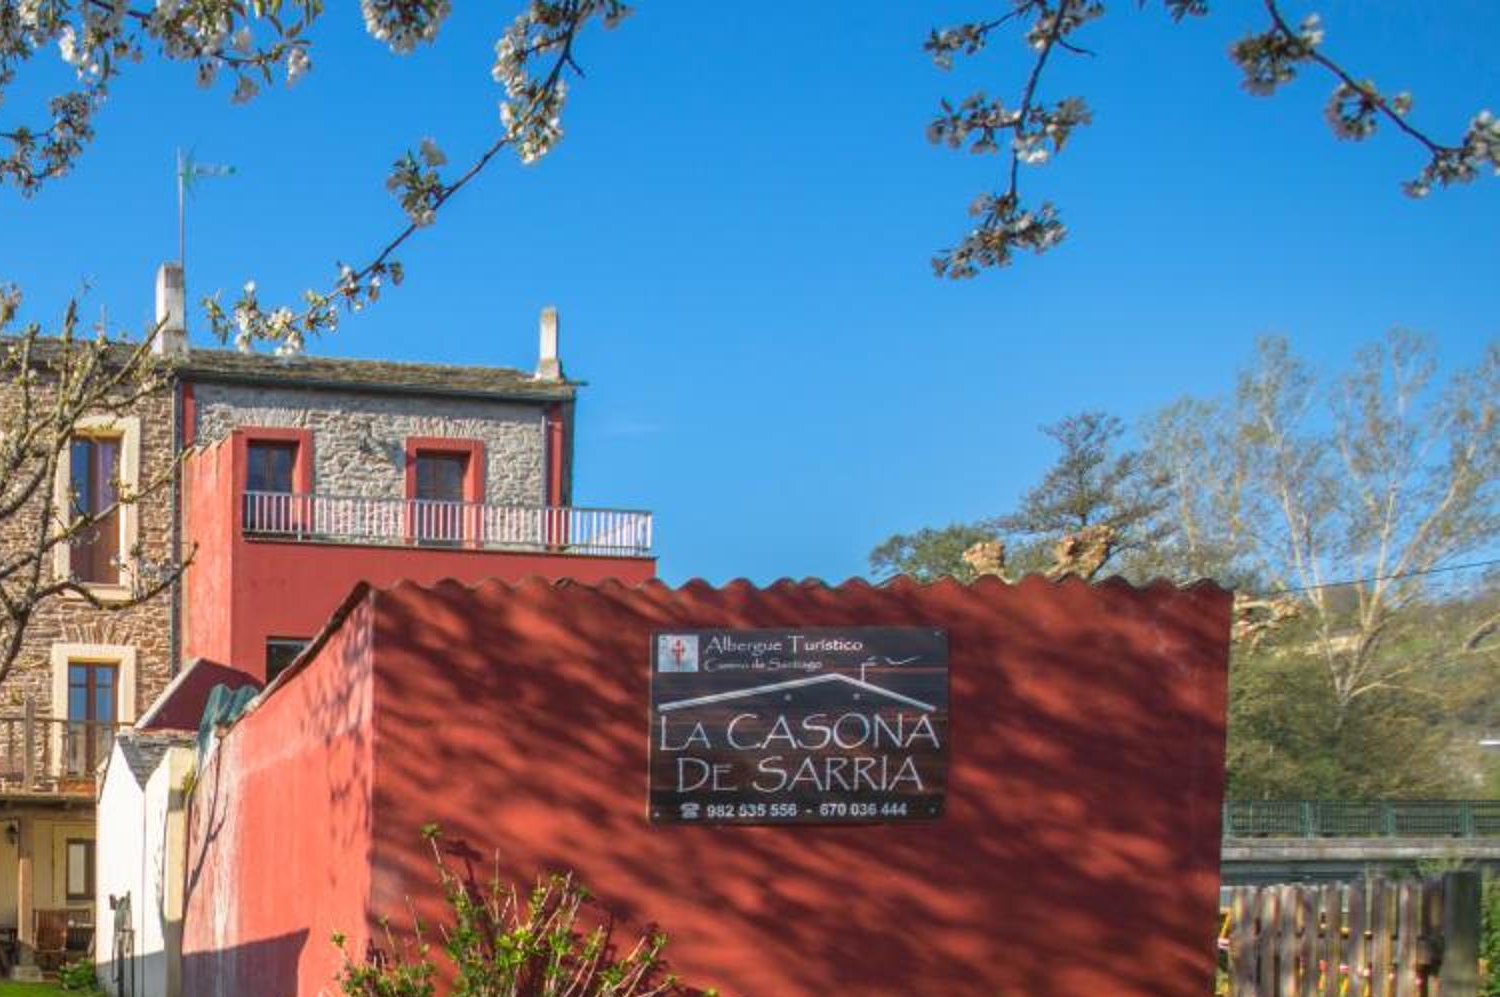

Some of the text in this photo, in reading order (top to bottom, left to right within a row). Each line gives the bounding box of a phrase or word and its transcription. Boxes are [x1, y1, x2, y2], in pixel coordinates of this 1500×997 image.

[704, 635, 783, 655] Albergue
[727, 712, 941, 751] CASONA
[751, 754, 925, 793] SARRIA
[706, 803, 735, 818] 982
[819, 802, 847, 817] 670
[850, 802, 877, 817] 036
[881, 802, 908, 817] 444
